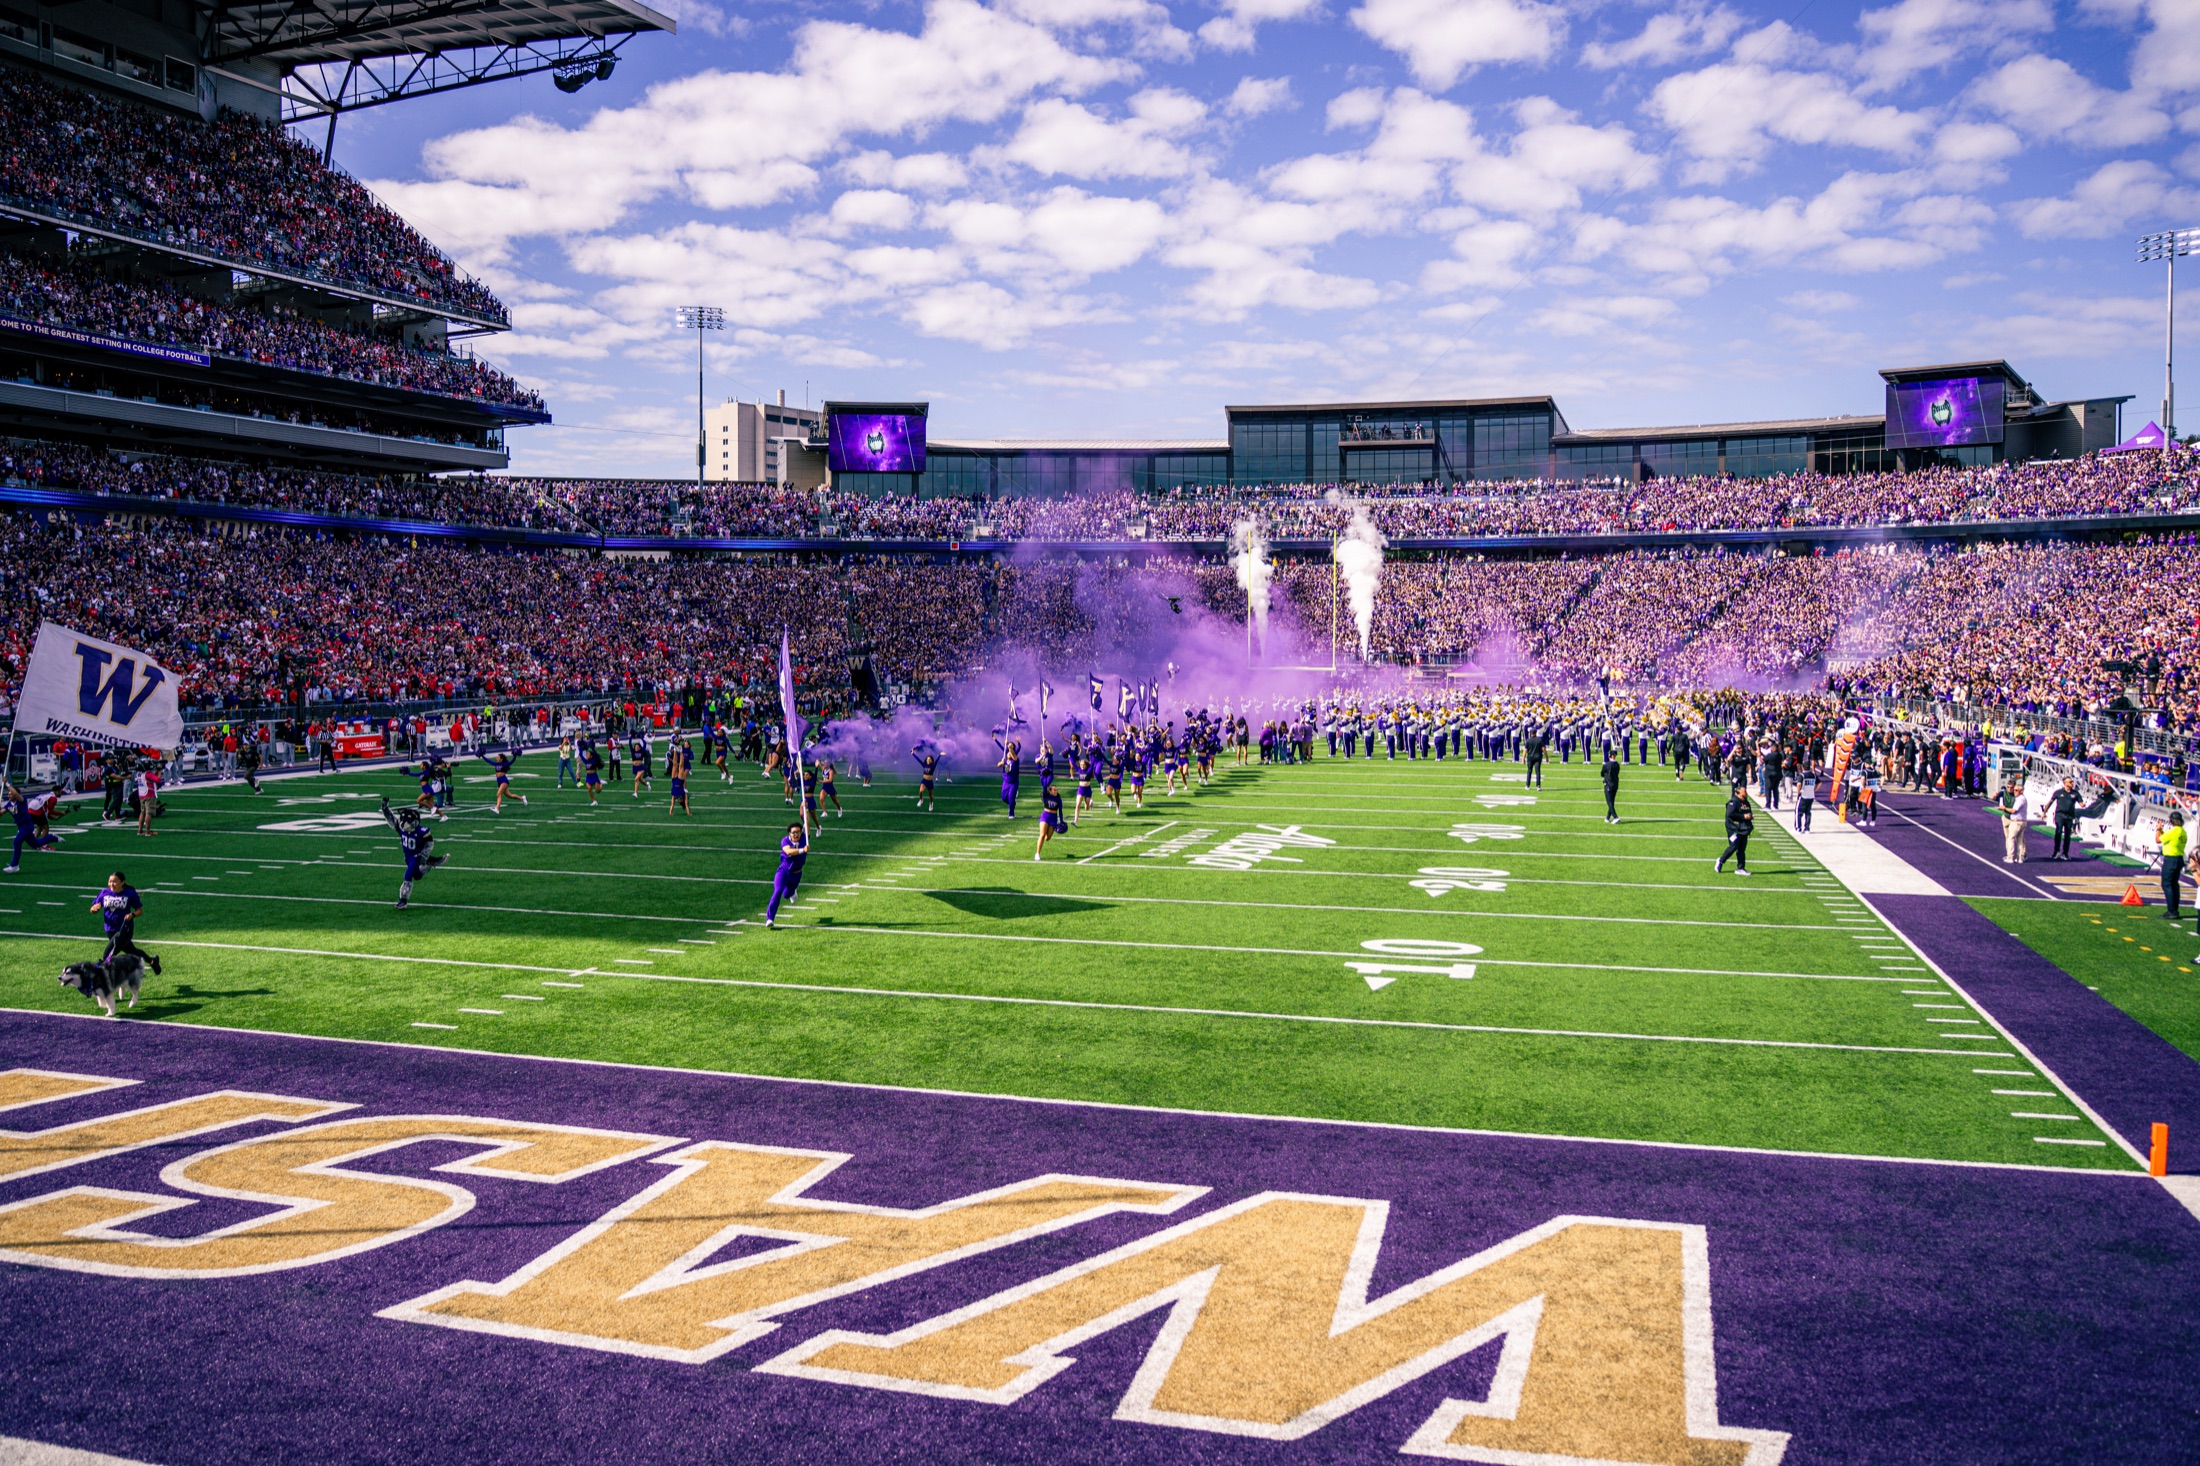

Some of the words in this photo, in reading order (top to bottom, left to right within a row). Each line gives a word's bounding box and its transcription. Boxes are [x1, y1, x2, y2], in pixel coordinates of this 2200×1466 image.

[0, 319, 19, 329] OME
[20, 323, 32, 331] TO
[33, 325, 49, 334] THE
[51, 328, 90, 342] GREATEST
[91, 336, 121, 348] SETTING
[123, 342, 131, 350] IN
[132, 343, 164, 356] COLLEGE
[166, 350, 202, 363] FOOTBALL
[847, 657, 866, 671] W
[72, 641, 166, 727] W
[1446, 823, 1527, 840] 30
[1408, 866, 1511, 892] 20
[1343, 938, 1484, 979] 10
